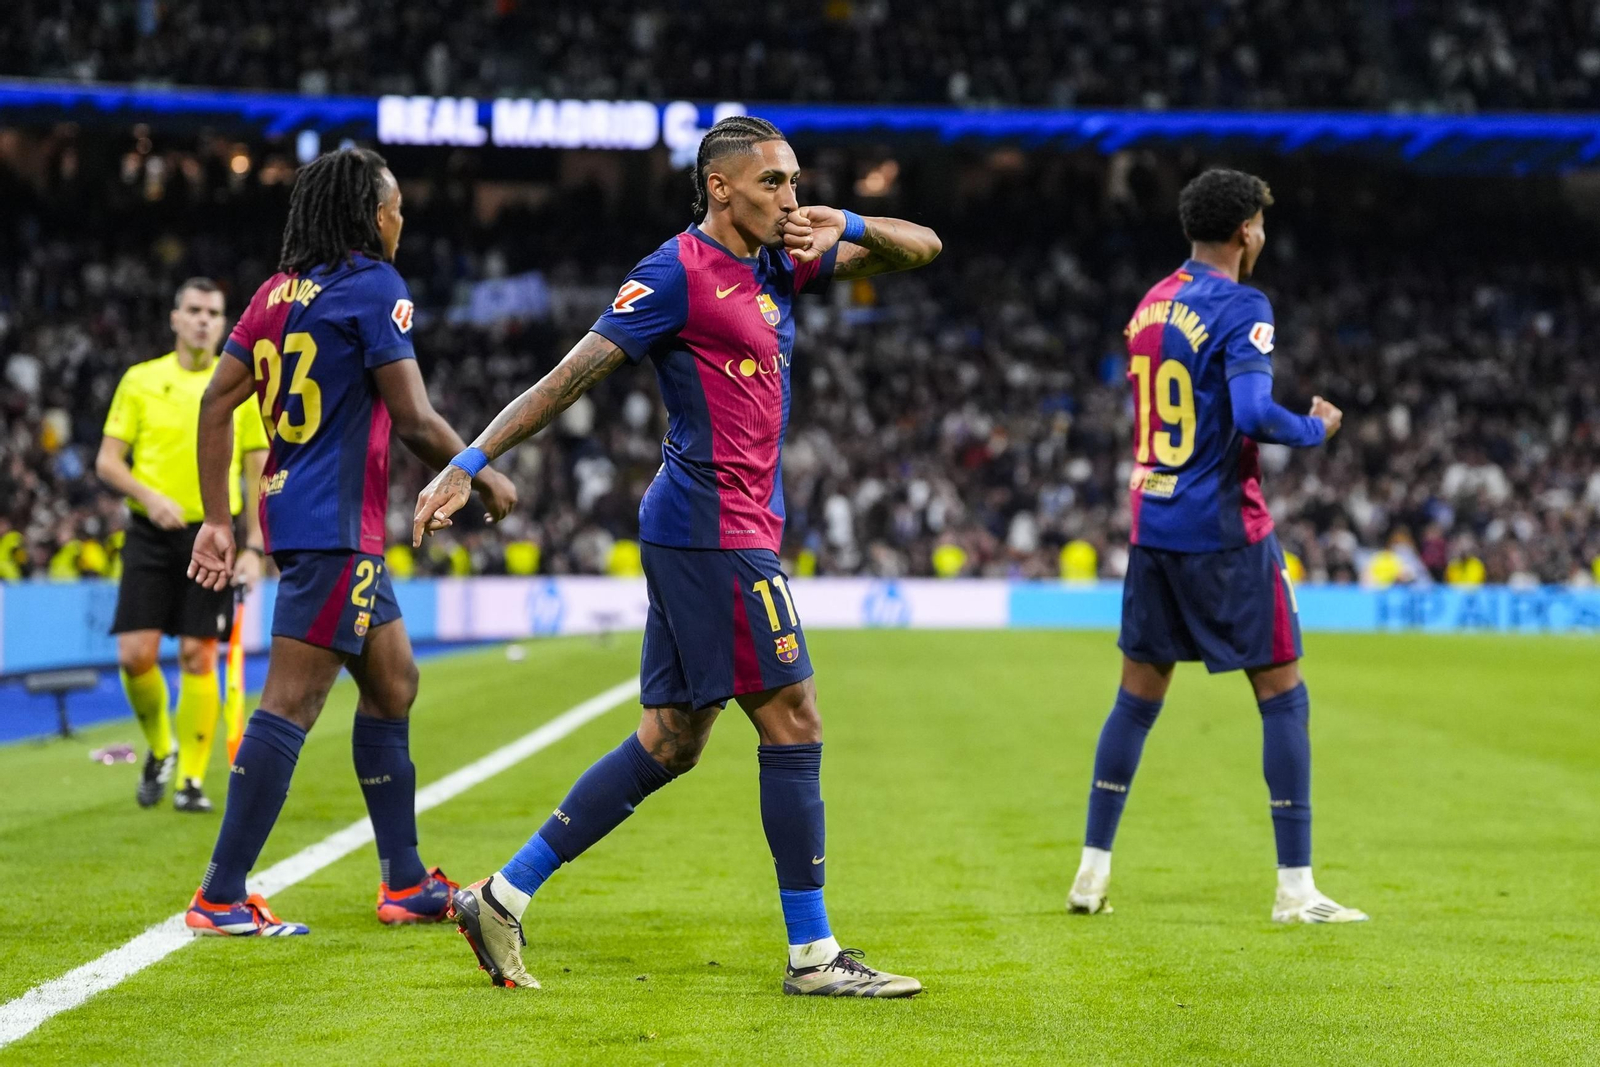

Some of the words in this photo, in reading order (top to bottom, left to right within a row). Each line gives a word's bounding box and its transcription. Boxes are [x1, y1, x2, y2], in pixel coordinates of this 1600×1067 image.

[378, 96, 486, 145] REAL
[493, 98, 659, 149] MADRID
[1169, 301, 1210, 354] YAMAL
[253, 331, 322, 445] 23
[1130, 355, 1197, 467] 19
[752, 575, 798, 632] 11
